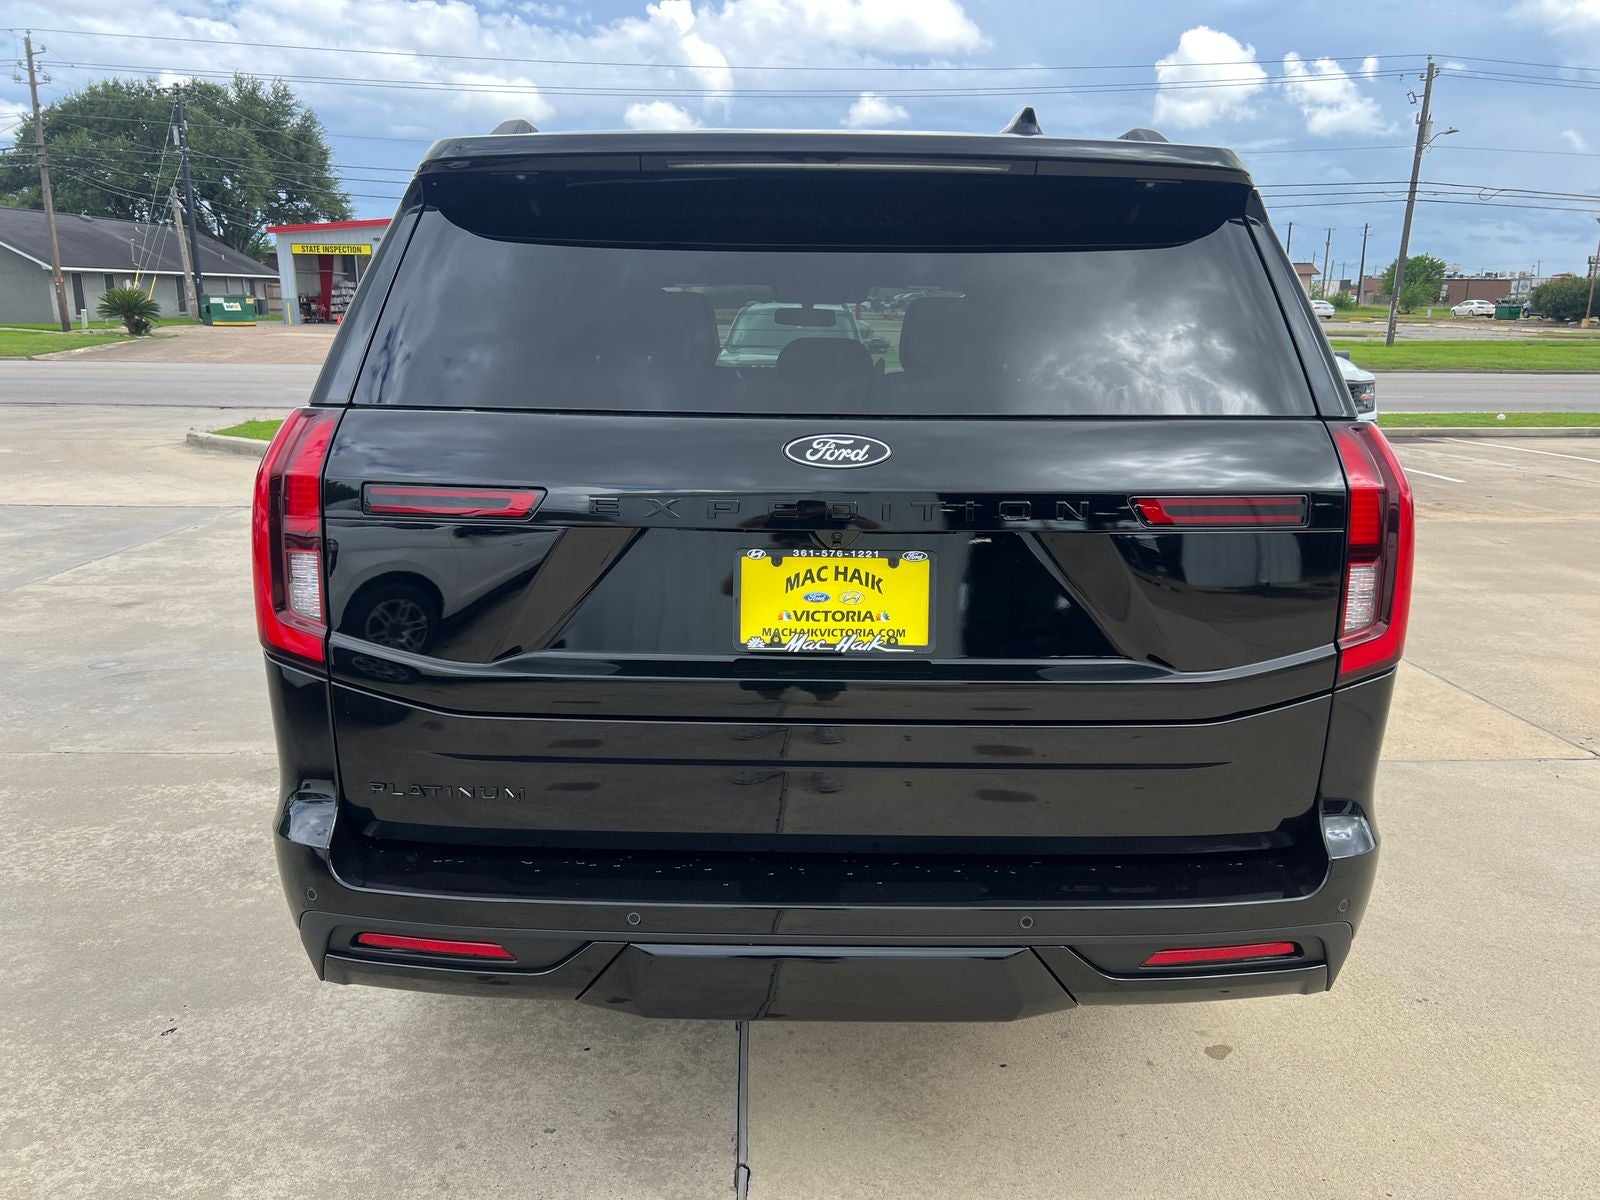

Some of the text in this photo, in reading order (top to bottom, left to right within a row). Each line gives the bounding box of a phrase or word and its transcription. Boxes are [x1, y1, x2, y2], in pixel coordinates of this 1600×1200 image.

[301, 245, 362, 254] STATE INSPECTION
[805, 438, 871, 462] Ford
[588, 496, 1090, 522] EXPEDITION
[792, 549, 880, 558] 361-576-1221
[784, 565, 884, 595] MAC HAIK
[806, 592, 827, 602] Ford
[792, 610, 875, 623] VICTORIA
[784, 632, 889, 653] Mac Haik
[368, 781, 527, 800] PLATINUM
